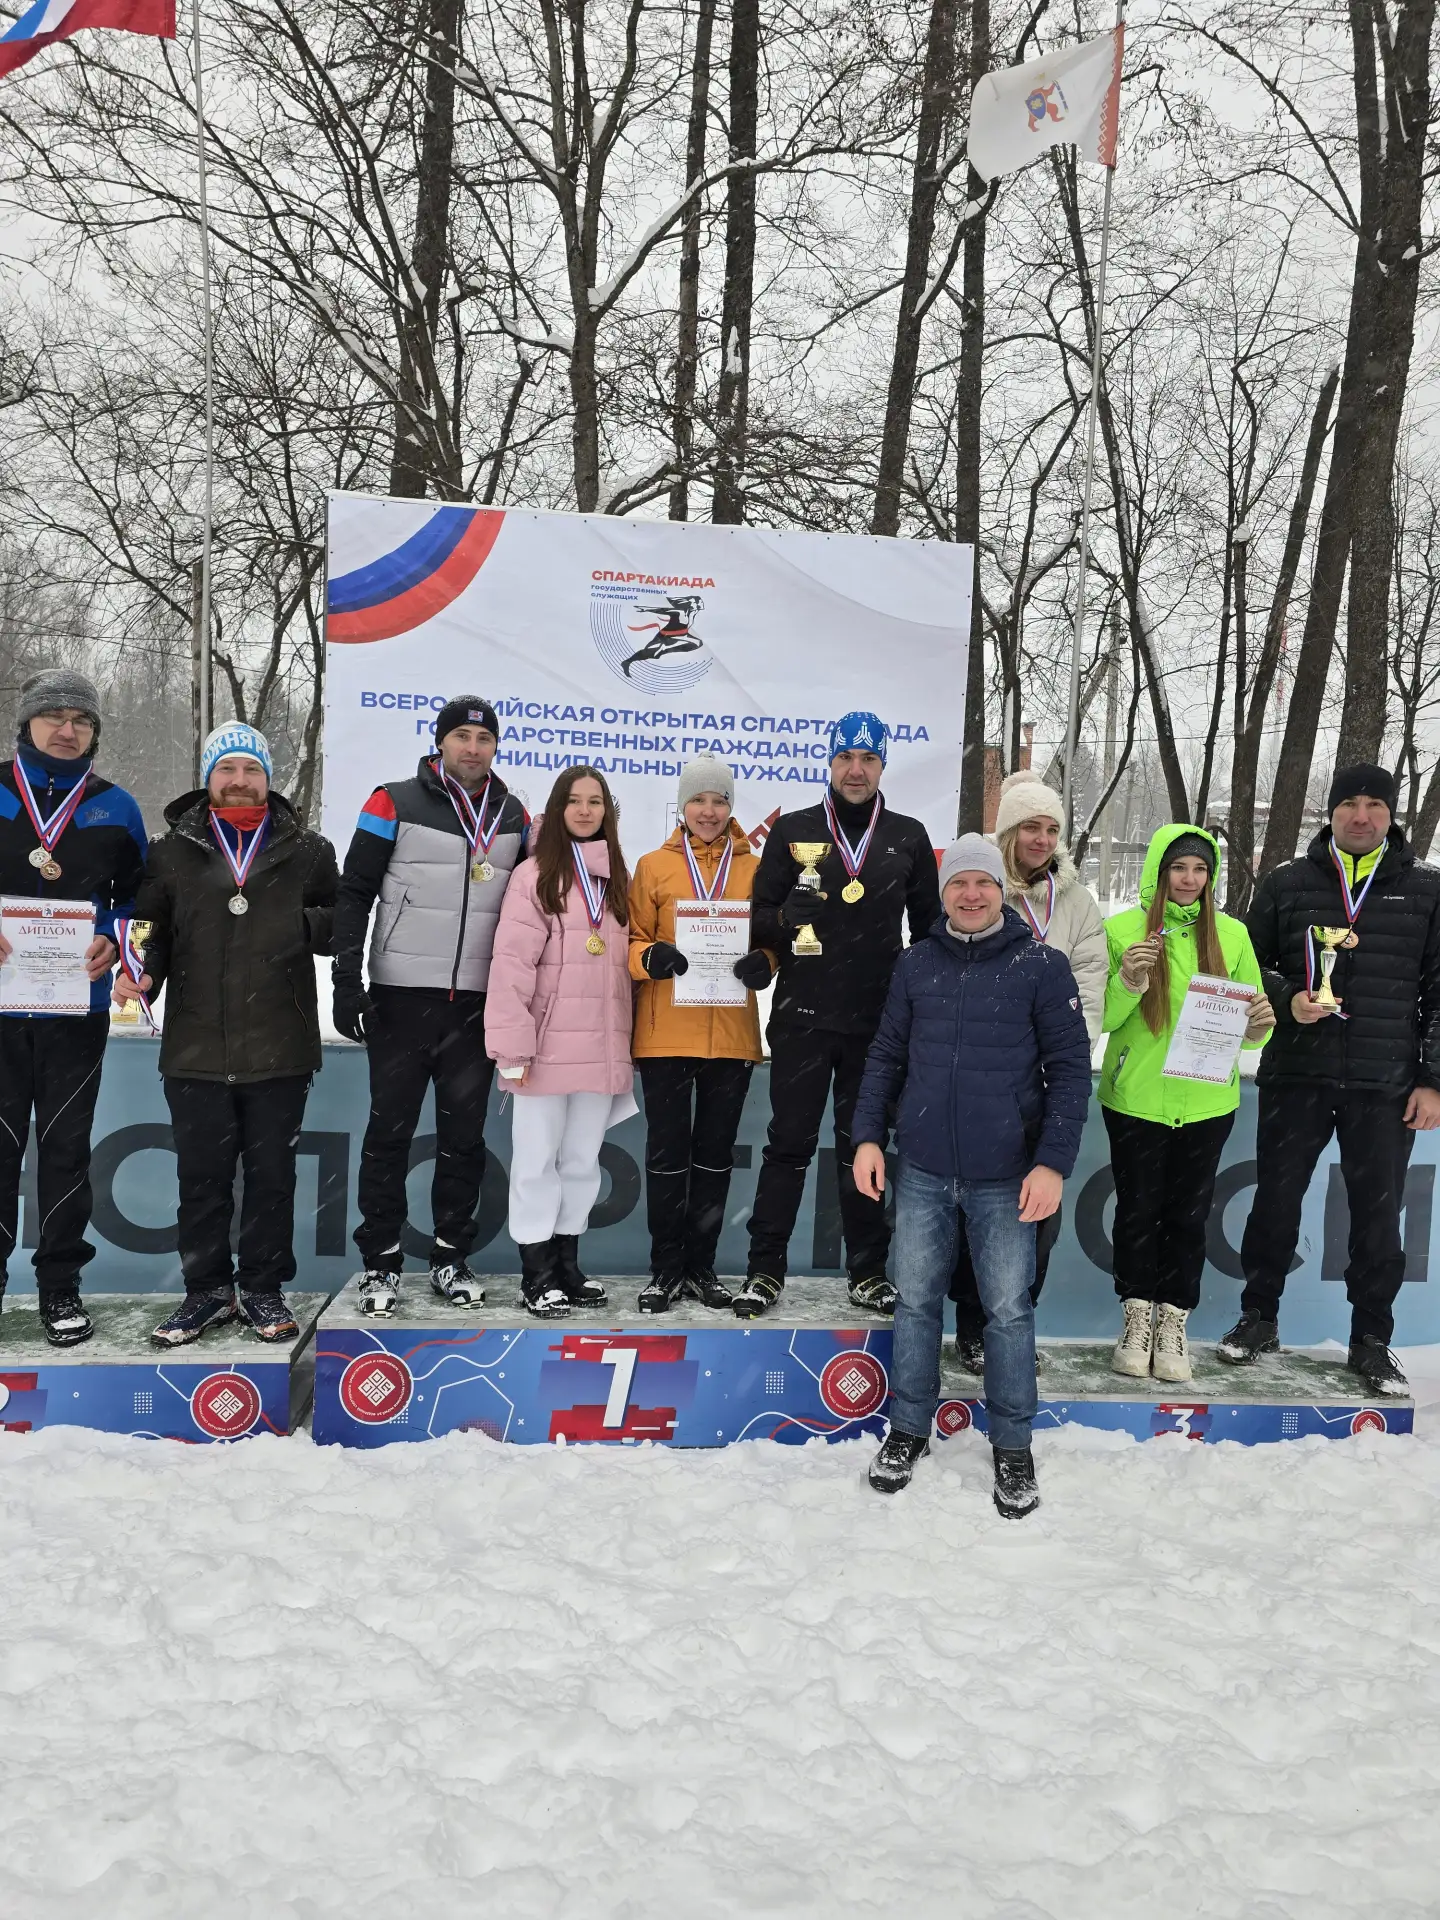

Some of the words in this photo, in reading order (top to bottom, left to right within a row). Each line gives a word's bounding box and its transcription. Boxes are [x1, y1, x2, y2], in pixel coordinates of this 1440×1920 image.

[591, 570, 716, 589] СПАРТАКИАДА
[360, 691, 595, 722] ВСЕРОИЙСКАЯ
[600, 708, 736, 731] ОТКРЫТАЯ
[681, 737, 827, 760] ГРАЖДАНС
[18, 926, 76, 936] ДИПЛОМ
[689, 924, 737, 934] ДИПЛОМ
[1194, 1000, 1239, 1015] ДИПЛОМ
[600, 1348, 638, 1428] 1
[1171, 1408, 1195, 1437] 3
